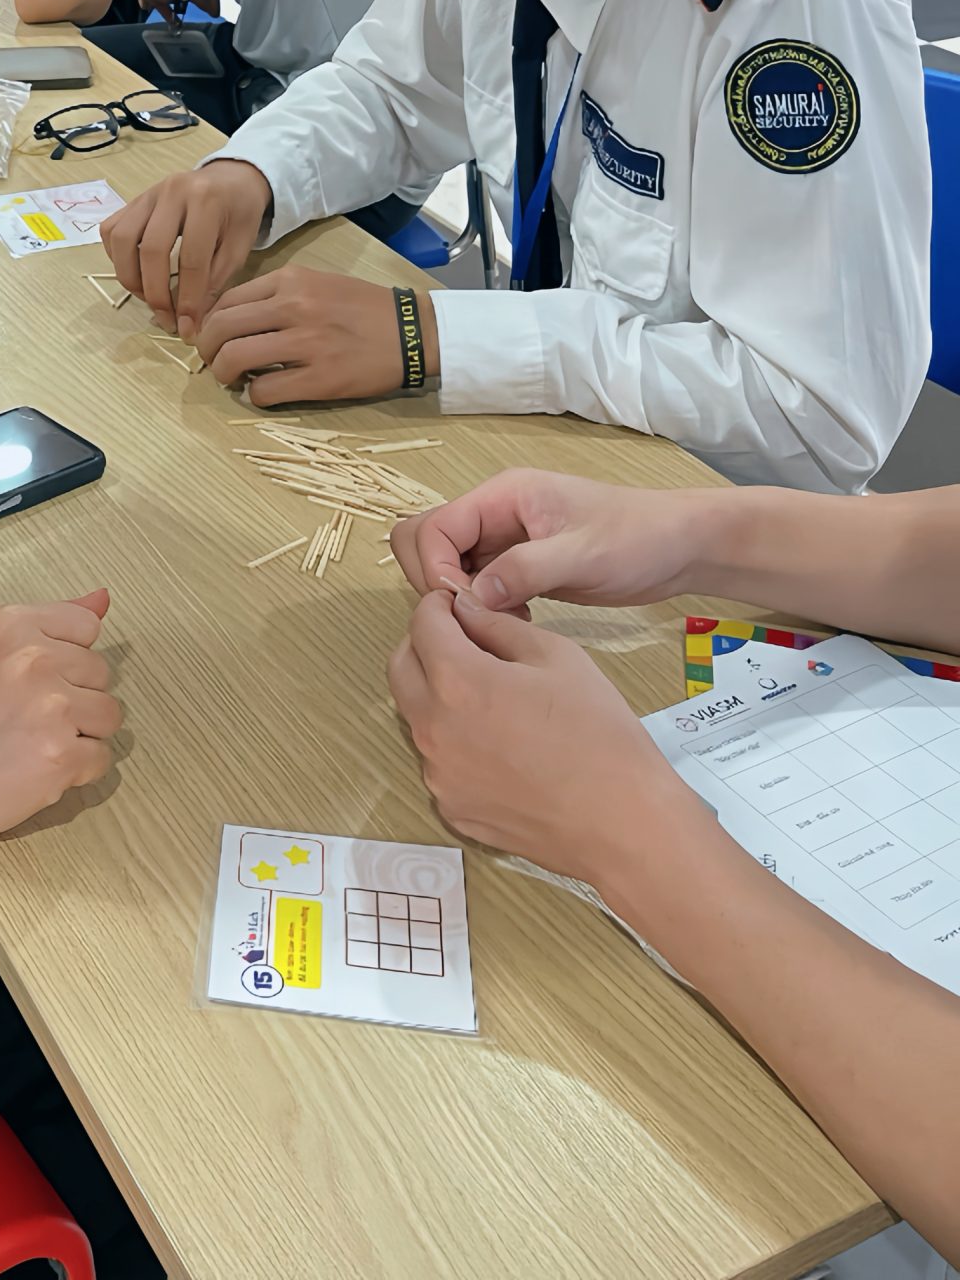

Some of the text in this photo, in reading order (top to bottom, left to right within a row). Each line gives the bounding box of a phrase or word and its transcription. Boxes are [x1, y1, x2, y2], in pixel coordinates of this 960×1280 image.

[753, 84, 826, 117] SAMURAI
[756, 115, 829, 128] SECURITY
[690, 695, 744, 721] VIASM
[253, 970, 273, 990] 15
